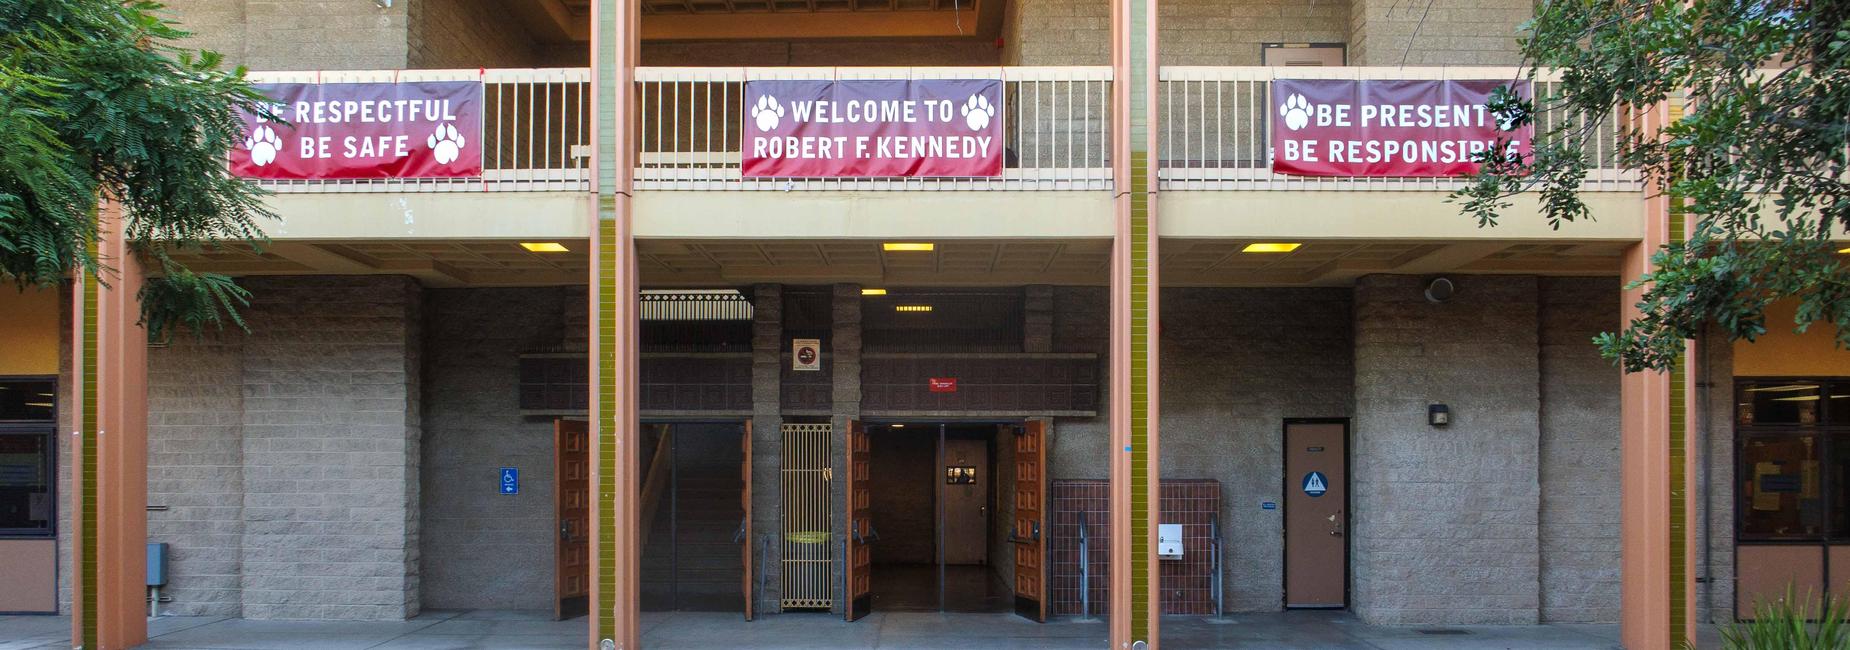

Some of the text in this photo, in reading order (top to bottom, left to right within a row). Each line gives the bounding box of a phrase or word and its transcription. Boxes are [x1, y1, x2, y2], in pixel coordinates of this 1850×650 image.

[256, 99, 457, 123] BE RESPECTFUL
[791, 100, 954, 123] WELCOME TO
[1316, 104, 1488, 127] BE PRESENT
[300, 135, 409, 158] BE SAFE
[753, 136, 993, 159] ROBERT F. KENNEDY
[1284, 139, 1318, 162] BE
